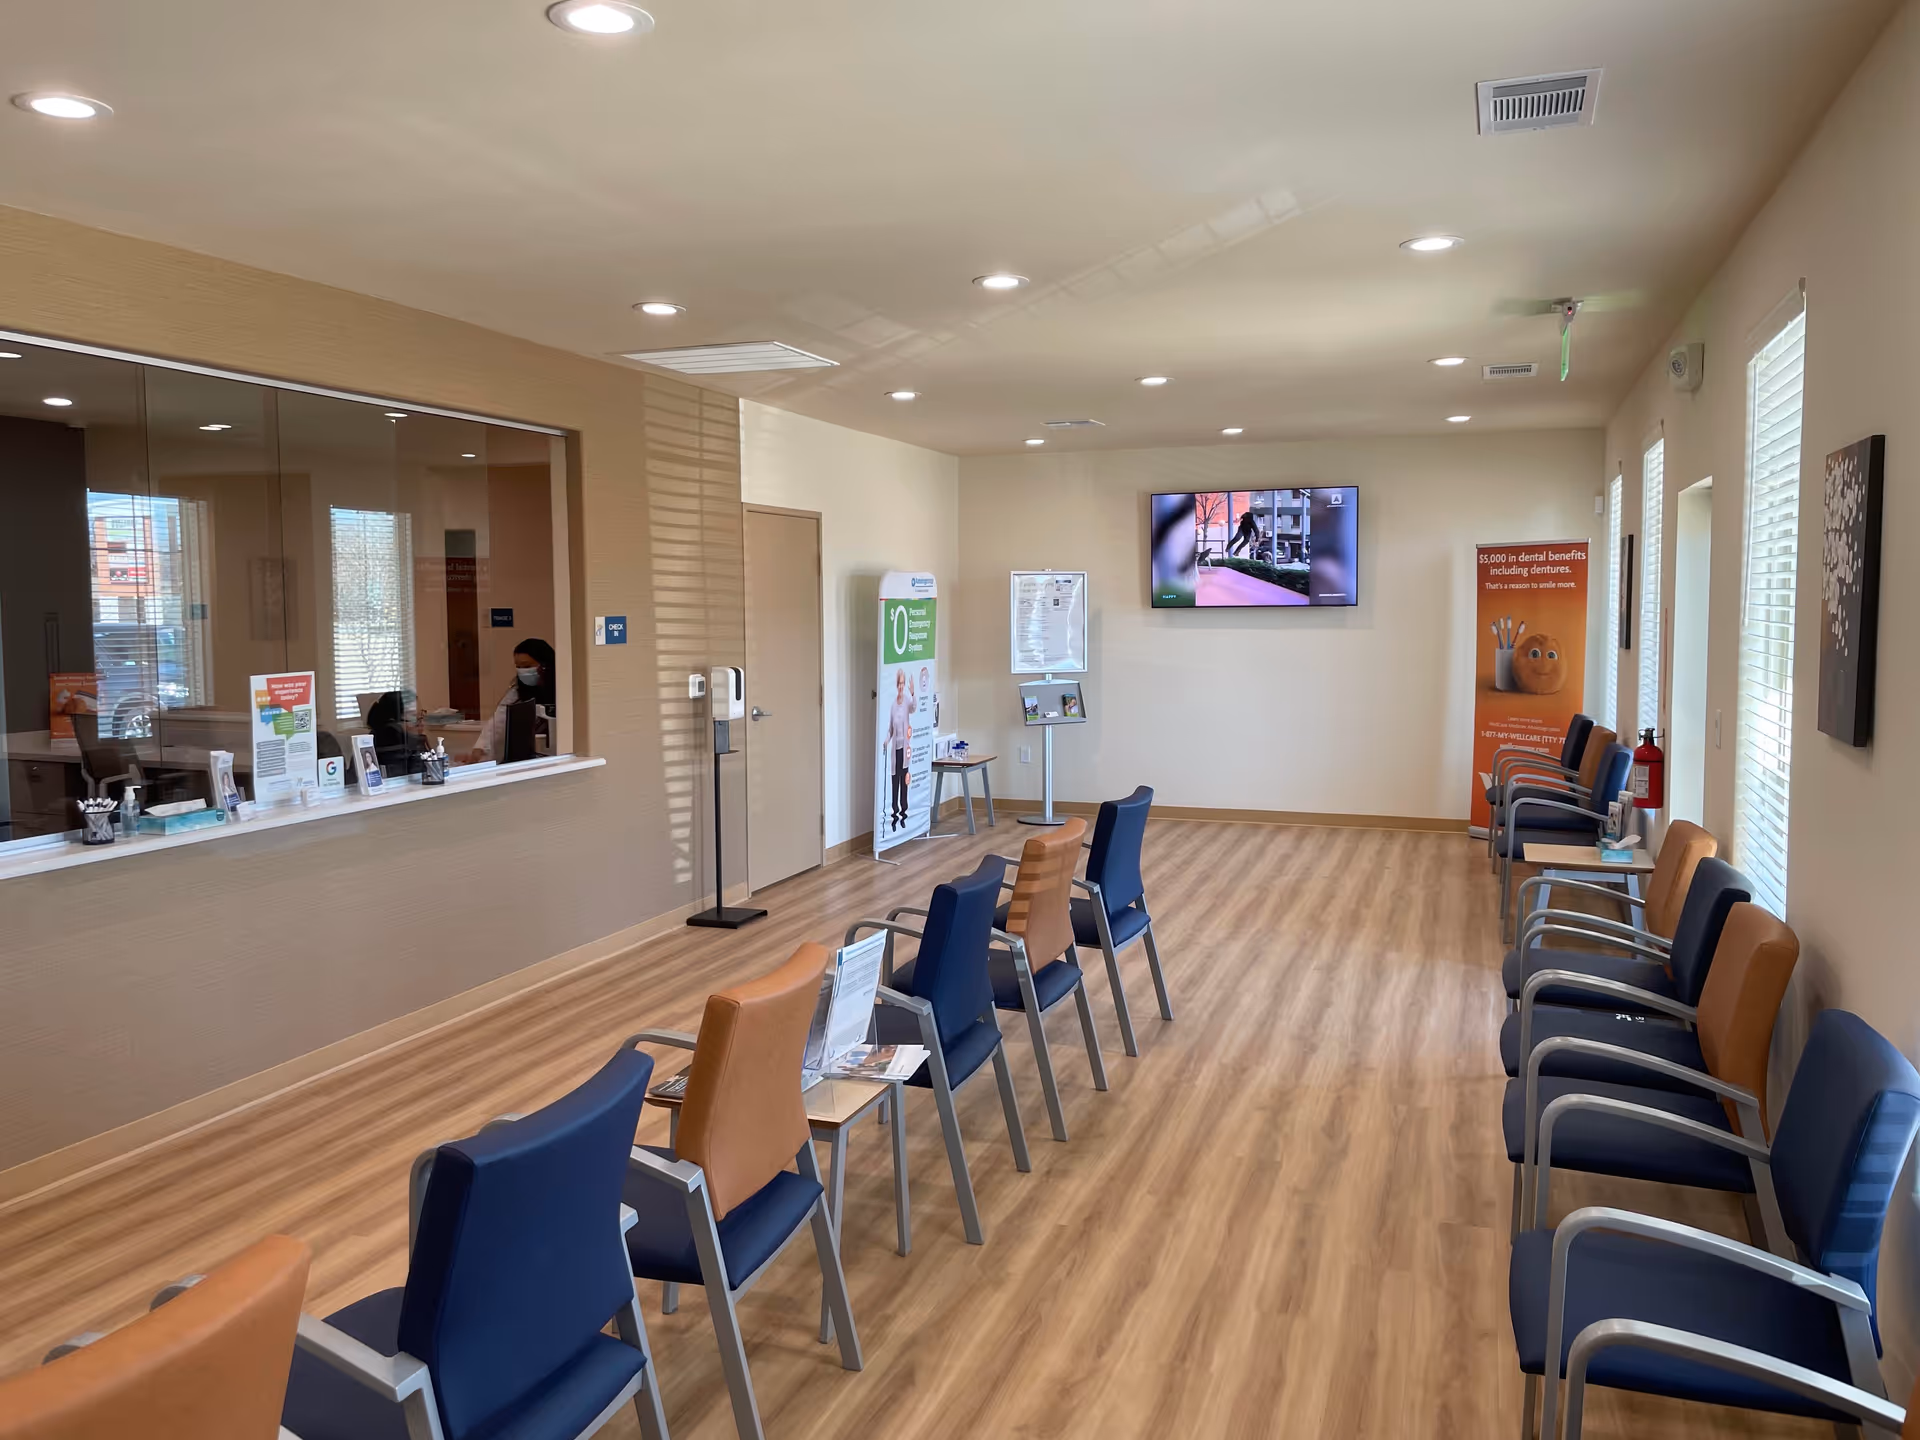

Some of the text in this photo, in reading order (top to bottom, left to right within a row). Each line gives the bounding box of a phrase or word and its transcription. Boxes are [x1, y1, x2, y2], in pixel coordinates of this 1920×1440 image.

[1479, 549, 1586, 564] $5,000 in dental benefits
[1490, 564, 1572, 577] including dentures.
[1485, 582, 1503, 590] That's
